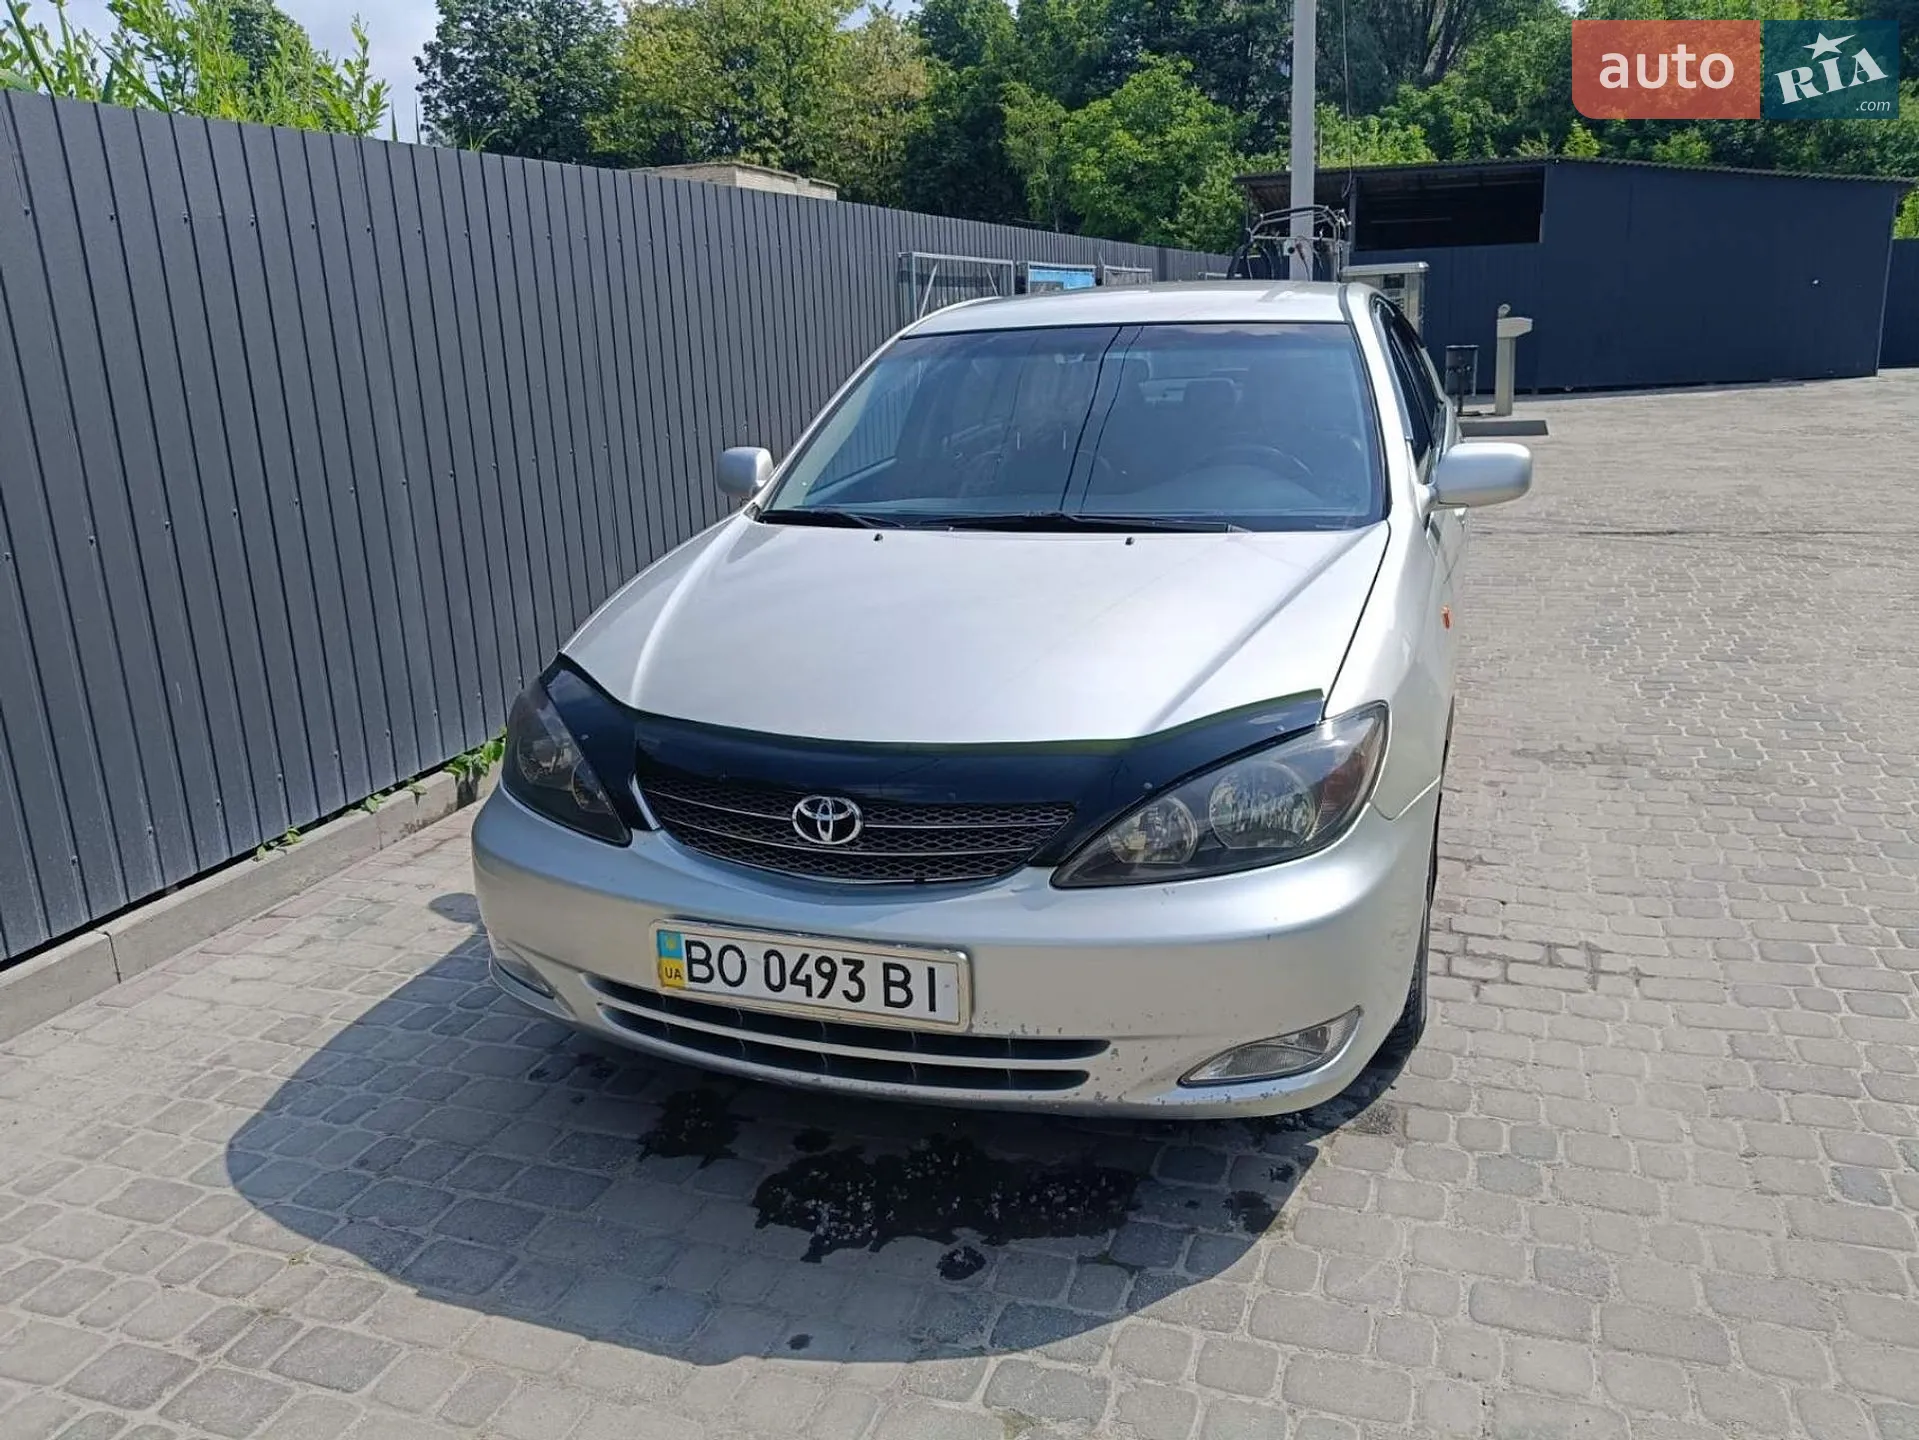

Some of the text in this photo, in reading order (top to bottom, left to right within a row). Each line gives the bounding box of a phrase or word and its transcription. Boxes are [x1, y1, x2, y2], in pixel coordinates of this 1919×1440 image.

[665, 967, 683, 981] UA
[685, 940, 936, 1012] BO 0493 BI
